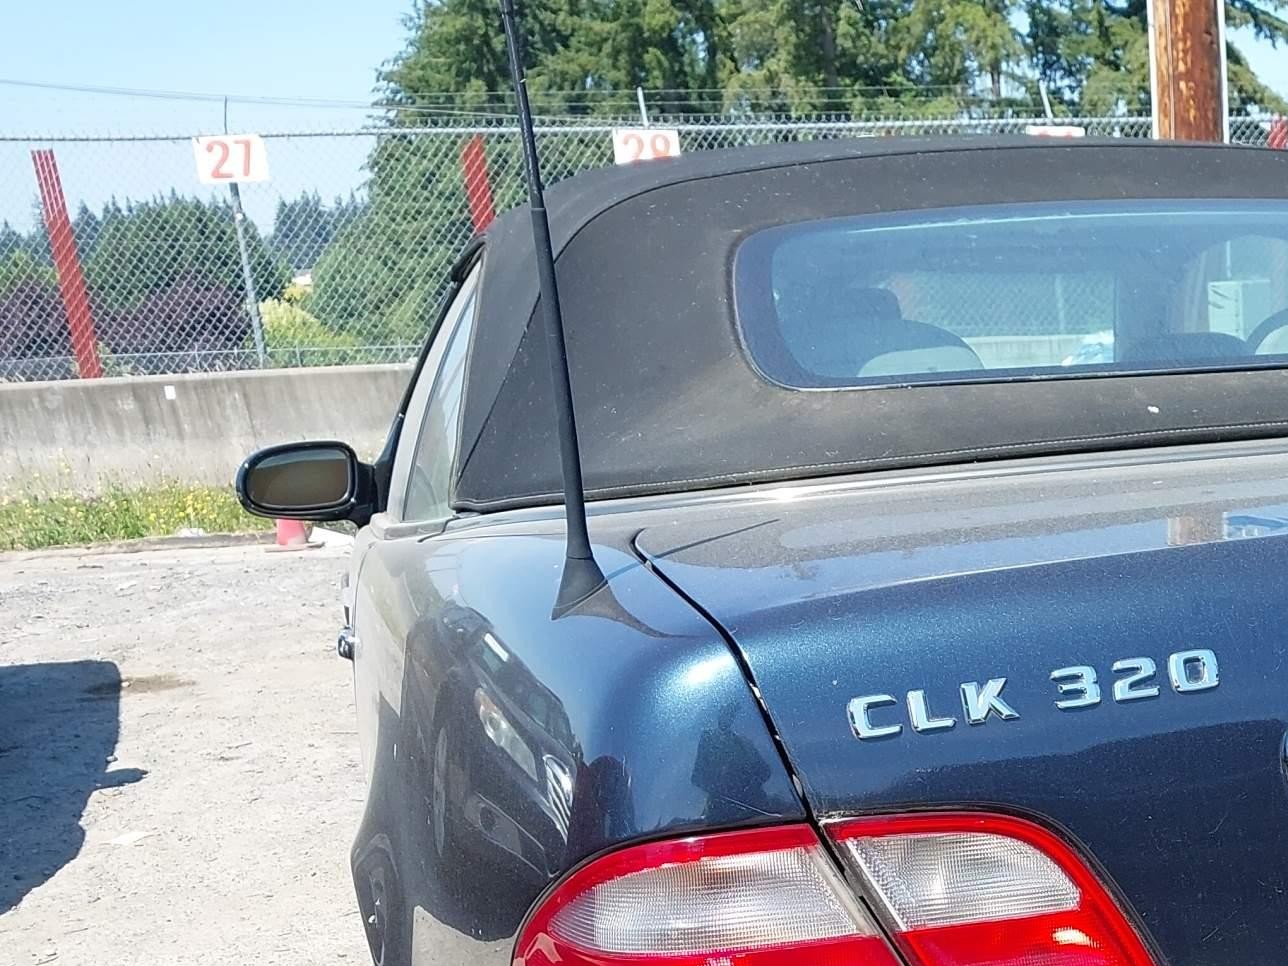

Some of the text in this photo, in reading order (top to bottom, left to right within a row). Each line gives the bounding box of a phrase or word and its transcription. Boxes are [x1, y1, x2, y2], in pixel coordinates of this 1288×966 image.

[206, 139, 251, 179] 27
[846, 648, 1221, 740] CLK 320
